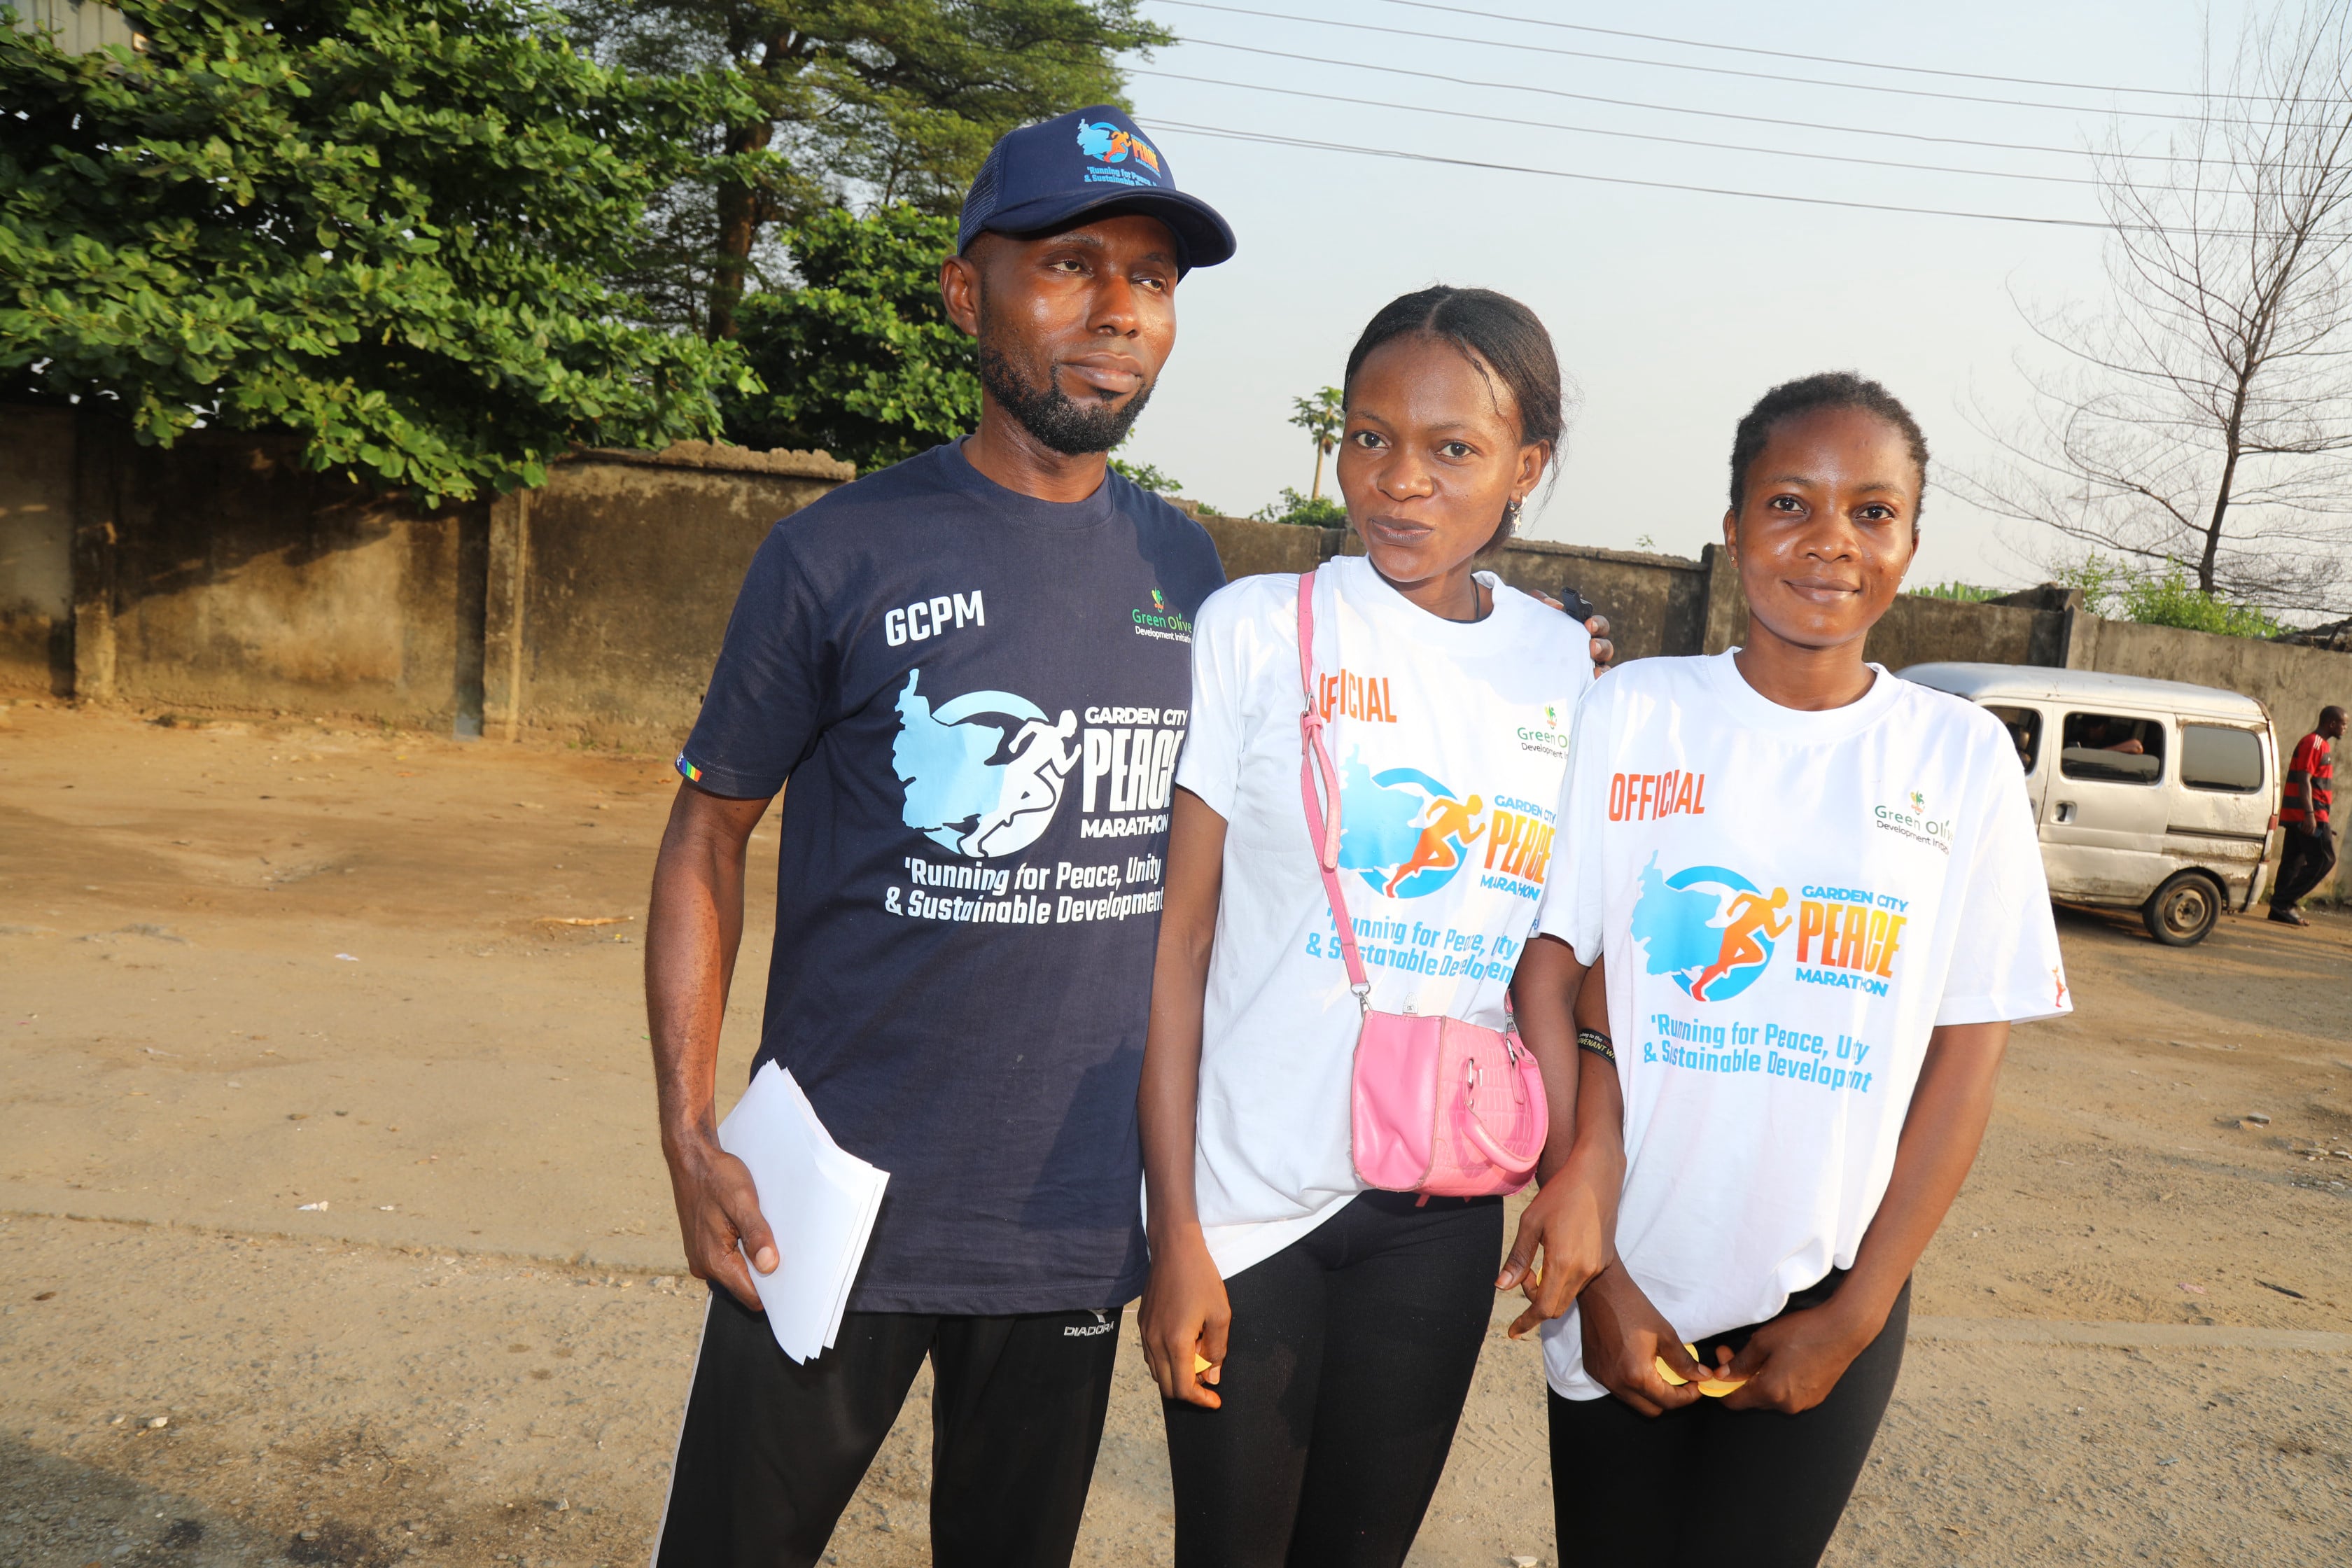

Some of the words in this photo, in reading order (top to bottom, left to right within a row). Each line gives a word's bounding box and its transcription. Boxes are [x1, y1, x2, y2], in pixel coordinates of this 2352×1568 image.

[885, 590, 985, 646] GCPM
[1132, 608, 1166, 628] Green
[1168, 612, 1192, 634] Olive
[1135, 625, 1175, 640] Development
[1084, 706, 1160, 724] GARDEN
[1163, 709, 1189, 726] CITY
[1517, 727, 1555, 746] Green
[1082, 728, 1185, 812] PEACE
[1494, 794, 1543, 818] GARDEN
[1609, 769, 1705, 821] OFFICIAL
[1080, 813, 1169, 839] MARATHON
[1875, 805, 1921, 831] Green
[1877, 820, 1931, 845] Development
[1484, 809, 1556, 884] PEACE
[904, 856, 1010, 896] 'Running
[1014, 862, 1051, 890] for
[1056, 862, 1121, 891] Peace,
[1126, 853, 1162, 885] Unity
[885, 886, 904, 916] &
[907, 890, 1051, 925] Sustainable
[1056, 886, 1165, 923] Development
[1802, 885, 1874, 904] GARDEN
[1877, 895, 1909, 912] CITY
[1306, 932, 1322, 959] &
[1411, 921, 1441, 948] for
[1796, 900, 1907, 979] PEACE
[1795, 967, 1889, 997] MARATHON
[1644, 1042, 1658, 1063] &
[1732, 1021, 1759, 1045] for
[1765, 1023, 1828, 1060] Peace,
[1064, 1320, 1114, 1336] DIADORA
